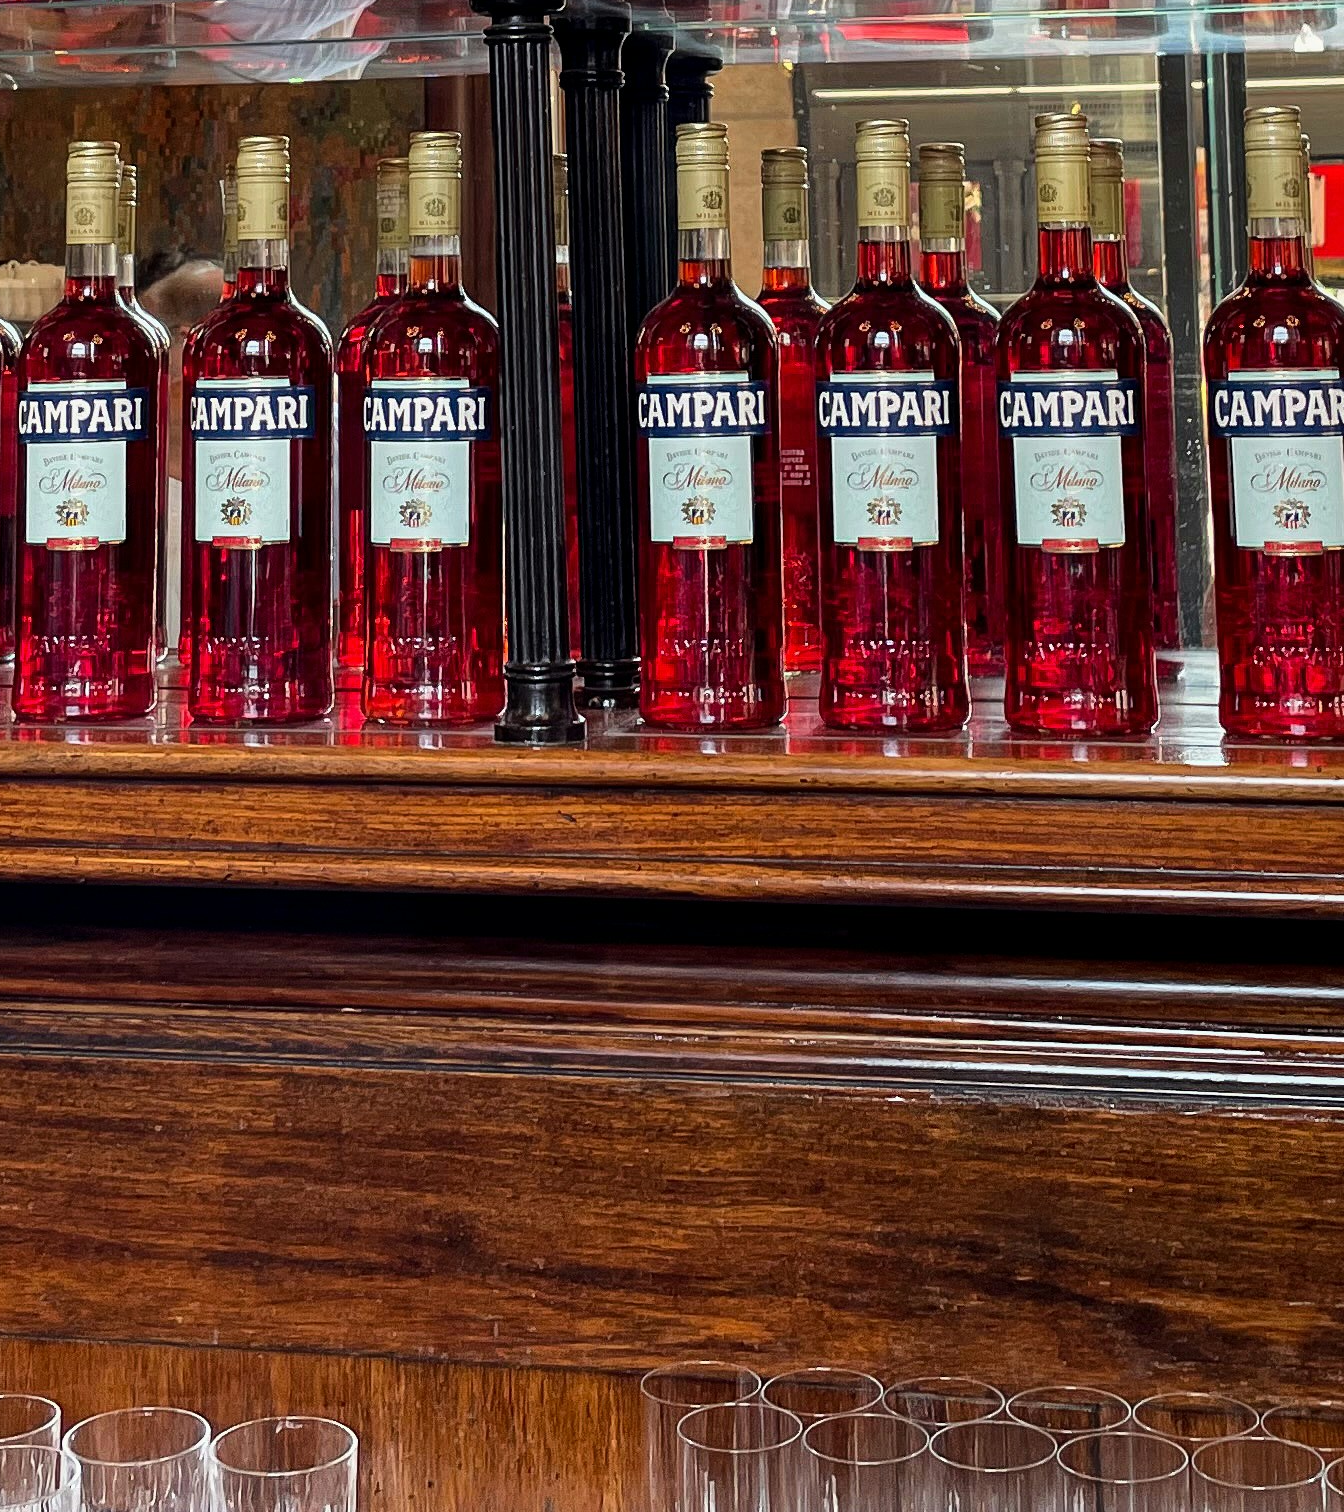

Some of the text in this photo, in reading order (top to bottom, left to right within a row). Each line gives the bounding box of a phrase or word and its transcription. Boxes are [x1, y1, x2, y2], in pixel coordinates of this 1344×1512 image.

[18, 398, 142, 434] CAMPARI
[364, 397, 485, 431] CAMPARI
[638, 391, 764, 428] CAMPARI
[818, 390, 949, 428] CAMPARI
[1000, 390, 1134, 428] CAMPARI
